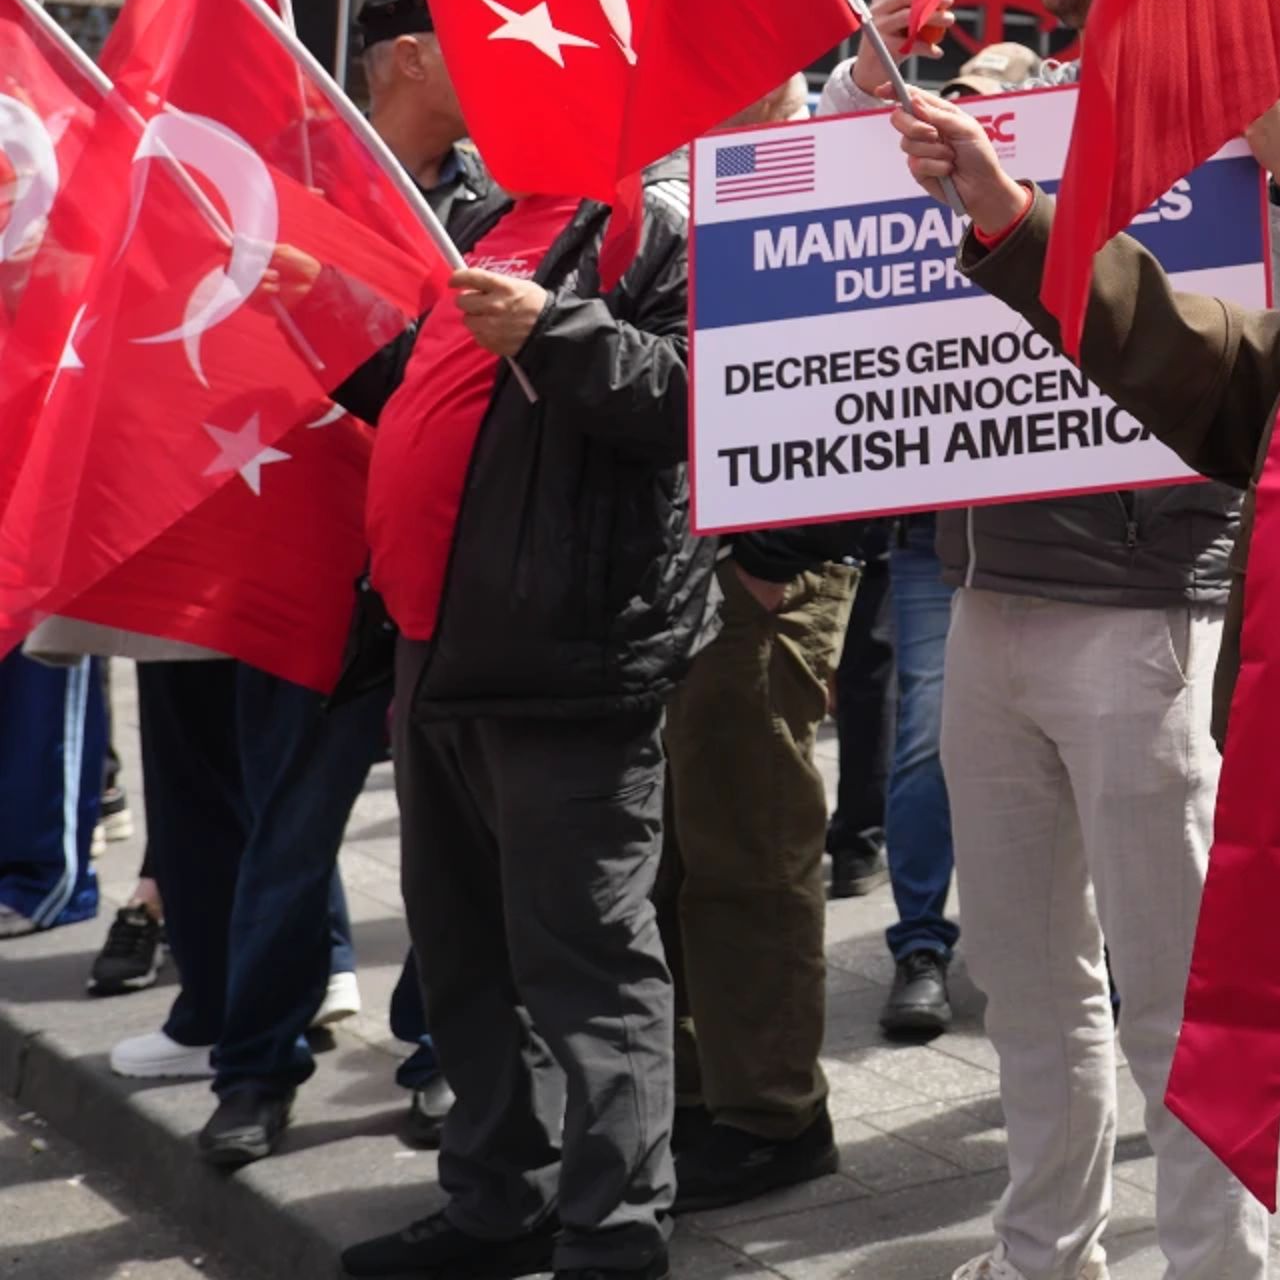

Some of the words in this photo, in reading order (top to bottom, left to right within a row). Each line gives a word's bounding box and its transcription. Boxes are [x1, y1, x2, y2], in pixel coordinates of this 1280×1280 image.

[836, 267, 914, 303] DUE
[724, 346, 900, 396] DECREES
[906, 328, 1063, 374] GENOC
[835, 386, 899, 424] ON
[902, 368, 1109, 419] INNOCEN
[718, 428, 928, 486] TURKISH
[943, 404, 1151, 464] AMERIC
